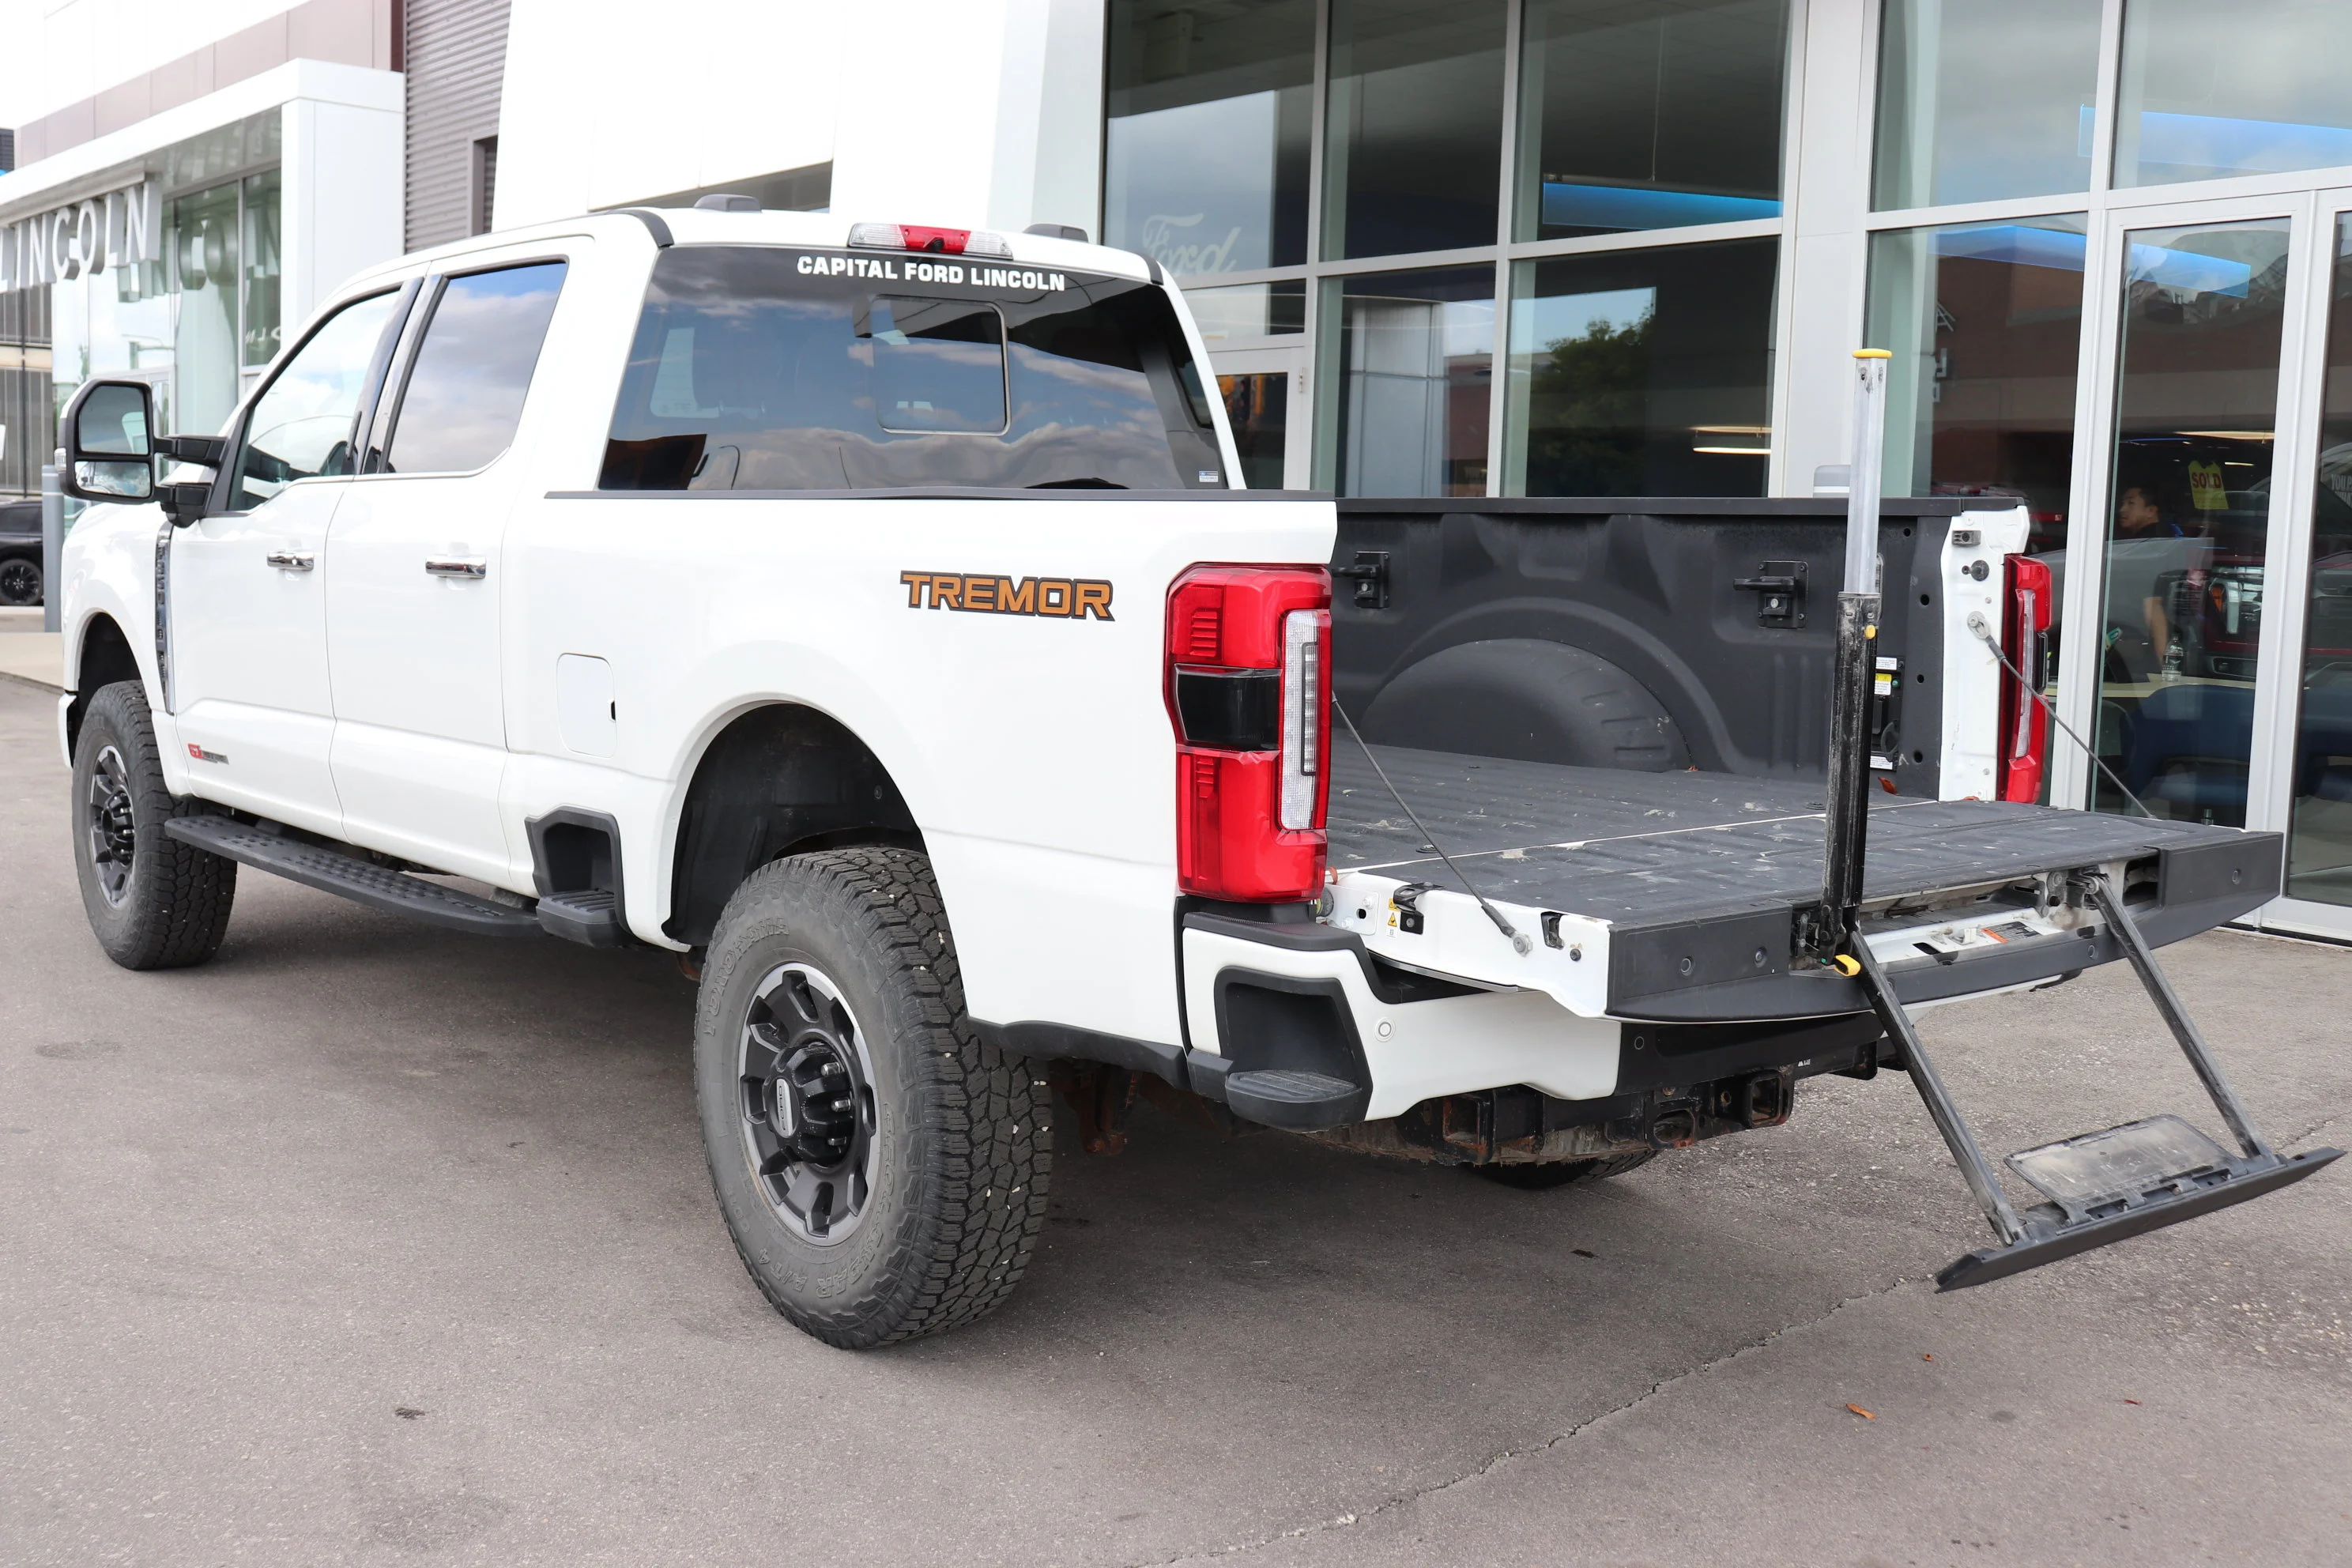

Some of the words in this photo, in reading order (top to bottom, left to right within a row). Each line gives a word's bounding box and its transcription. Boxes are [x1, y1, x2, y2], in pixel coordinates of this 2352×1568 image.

[0, 181, 153, 293] LINCOLN
[1142, 212, 1242, 275] Ford
[797, 256, 898, 280] CAPITAL
[904, 262, 963, 284] FORD
[971, 267, 1065, 292] LINCOLN
[2192, 472, 2222, 488] SOLD
[900, 570, 1115, 621] TREMOR
[703, 916, 790, 1036] YOKOHAMA
